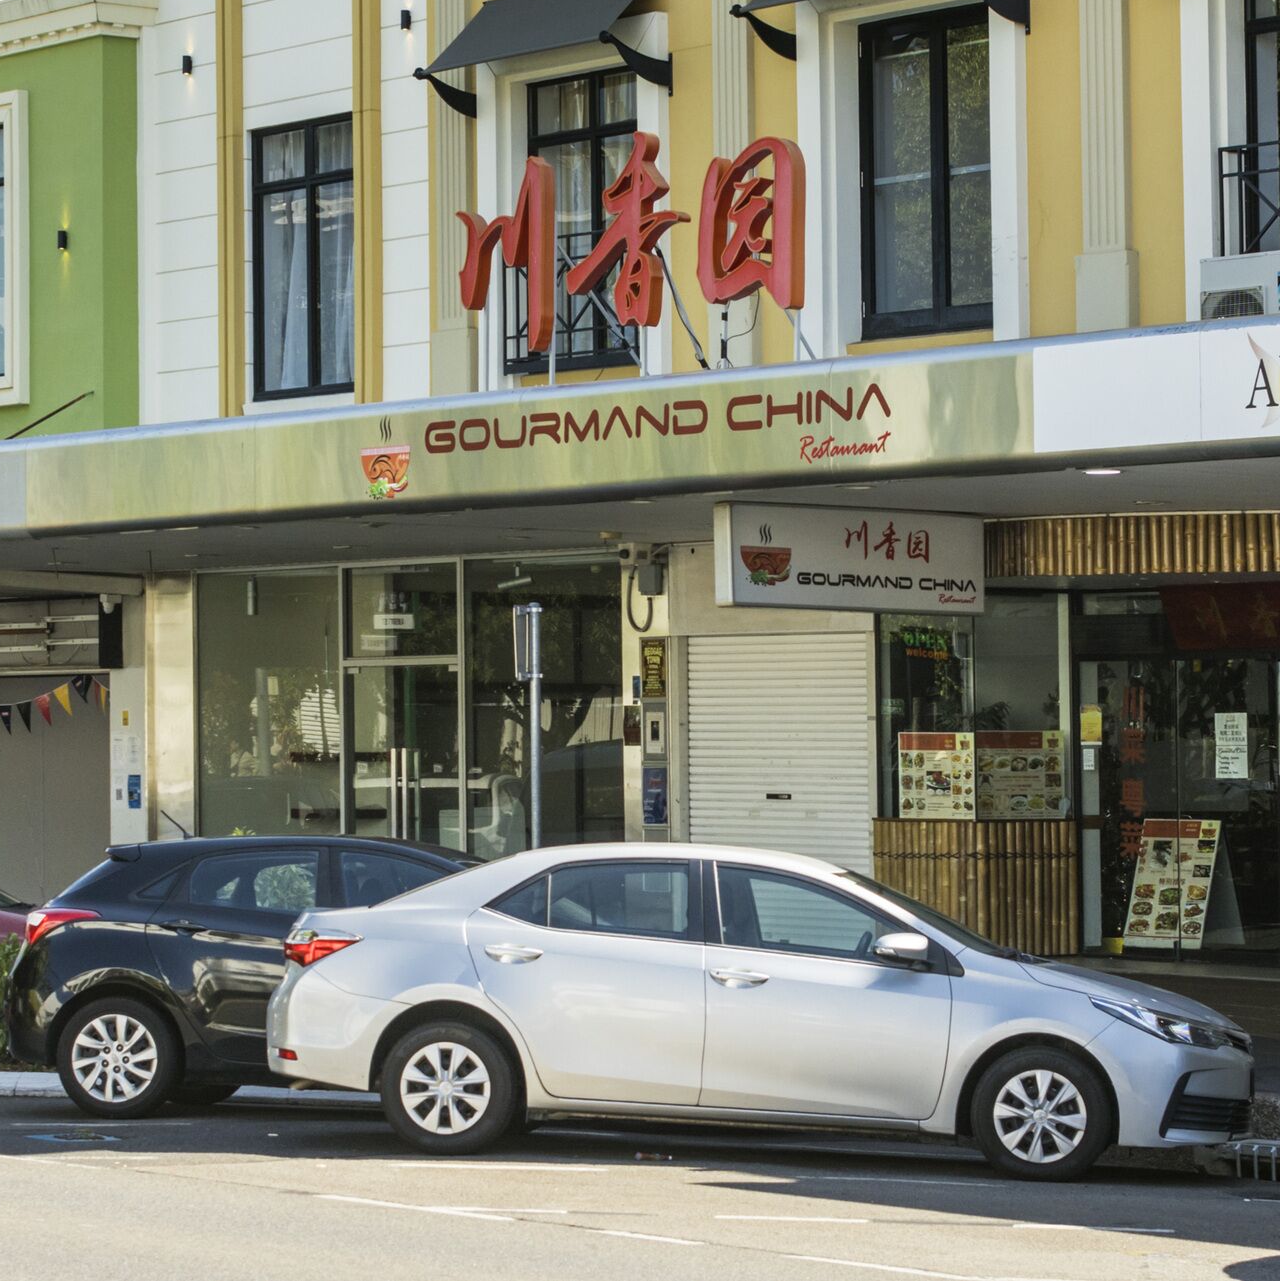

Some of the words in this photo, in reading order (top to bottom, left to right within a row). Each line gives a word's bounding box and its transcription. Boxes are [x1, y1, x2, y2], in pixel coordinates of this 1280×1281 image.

[455, 131, 806, 352] 川香园
[424, 399, 708, 454] GOURMAND
[726, 382, 891, 431] CHINA
[800, 431, 891, 464] Restaurant
[844, 519, 930, 563] 川香园
[797, 572, 913, 590] GOURMAND
[919, 578, 977, 592] CHINA
[938, 593, 976, 604] Restaurant
